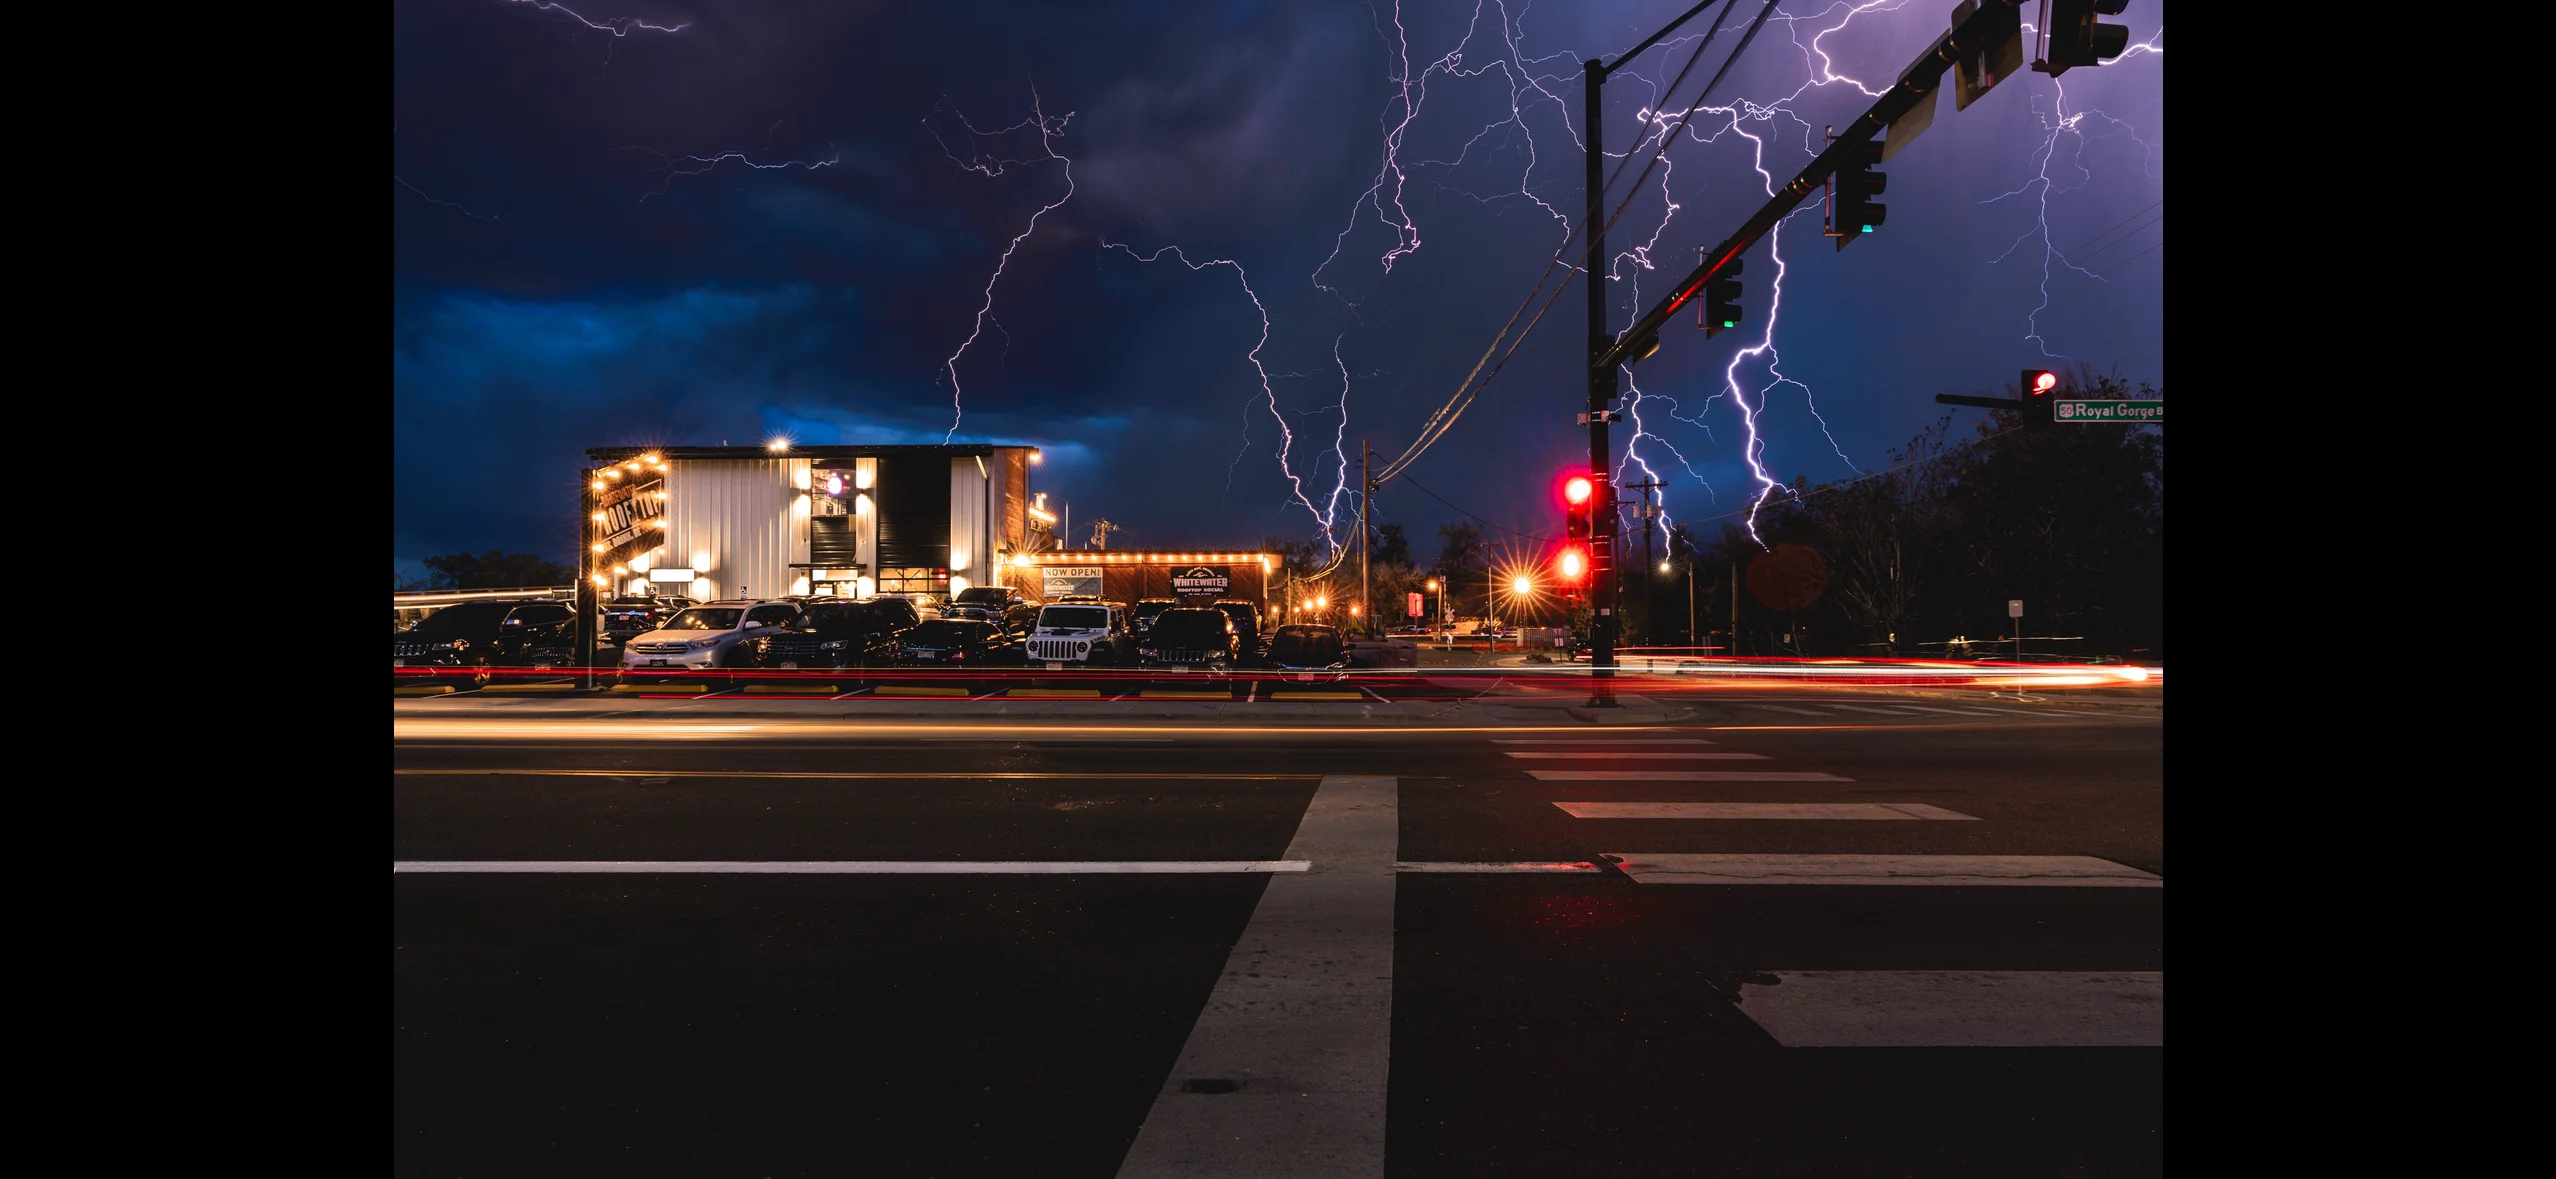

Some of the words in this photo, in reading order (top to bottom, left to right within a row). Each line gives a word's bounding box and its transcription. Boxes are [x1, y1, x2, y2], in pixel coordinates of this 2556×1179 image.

[2075, 403, 2114, 419] Royal
[2117, 403, 2155, 419] Gorge
[1045, 568, 1067, 576] NOW
[1071, 568, 1100, 576] OPEN!
[1173, 577, 1228, 587] WHITEWATER
